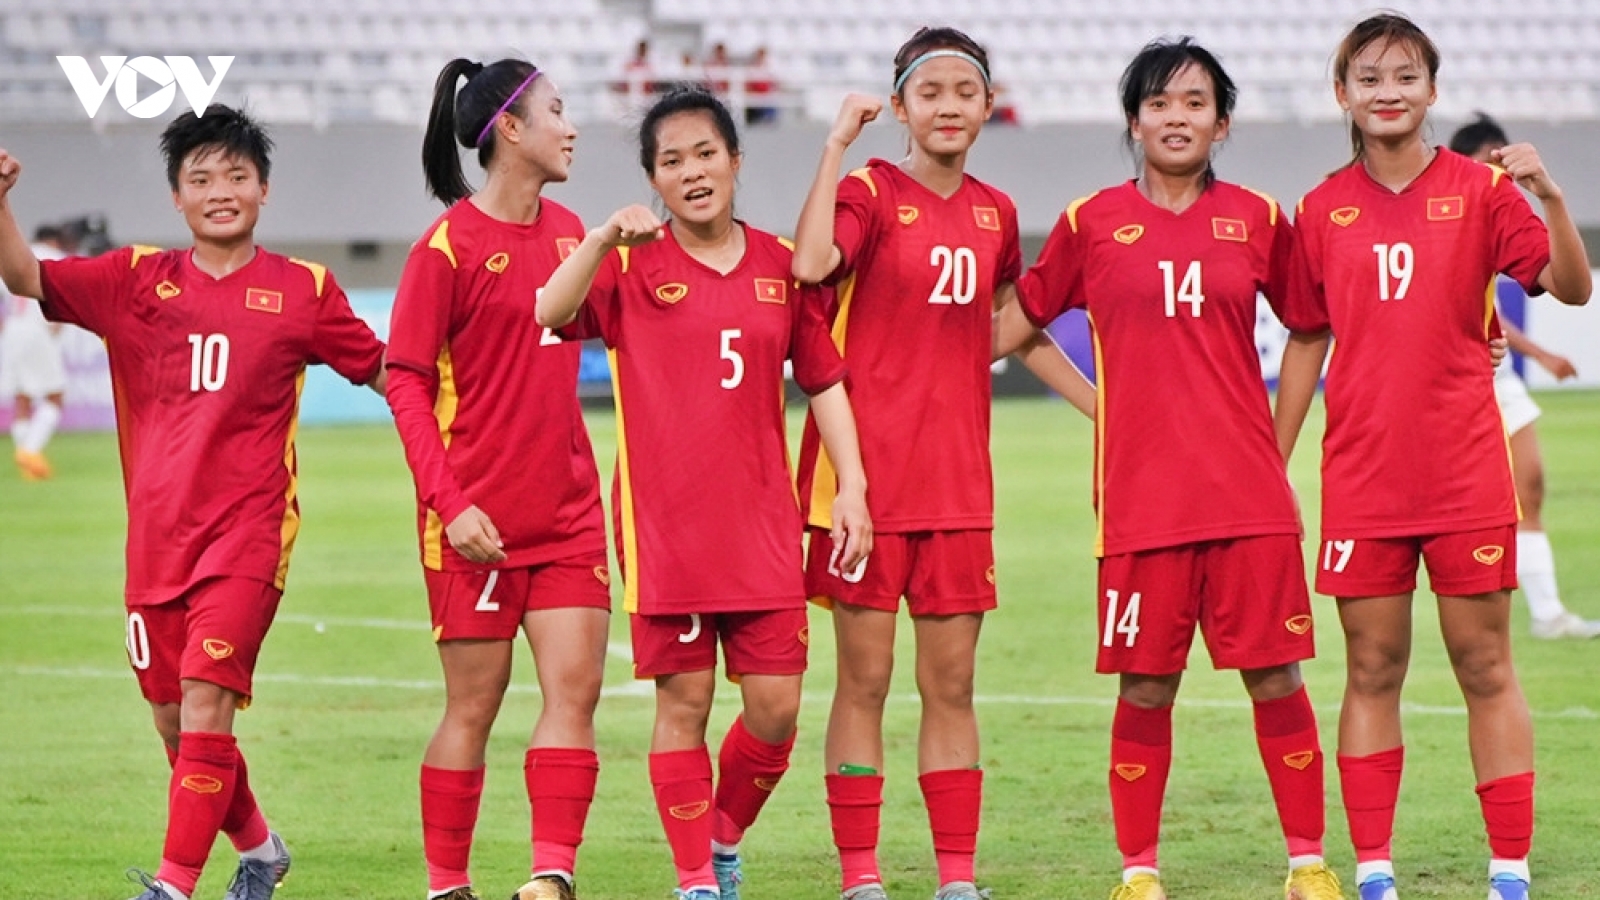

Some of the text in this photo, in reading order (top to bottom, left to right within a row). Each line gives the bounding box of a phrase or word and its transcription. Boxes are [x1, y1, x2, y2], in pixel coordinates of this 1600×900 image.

[928, 246, 977, 306] 20
[1157, 260, 1205, 318] 14
[1372, 242, 1414, 301] 19
[187, 333, 230, 393] 10
[719, 329, 745, 390] 5
[475, 570, 500, 611] 2
[1103, 589, 1142, 648] 14
[126, 611, 151, 670] 0
